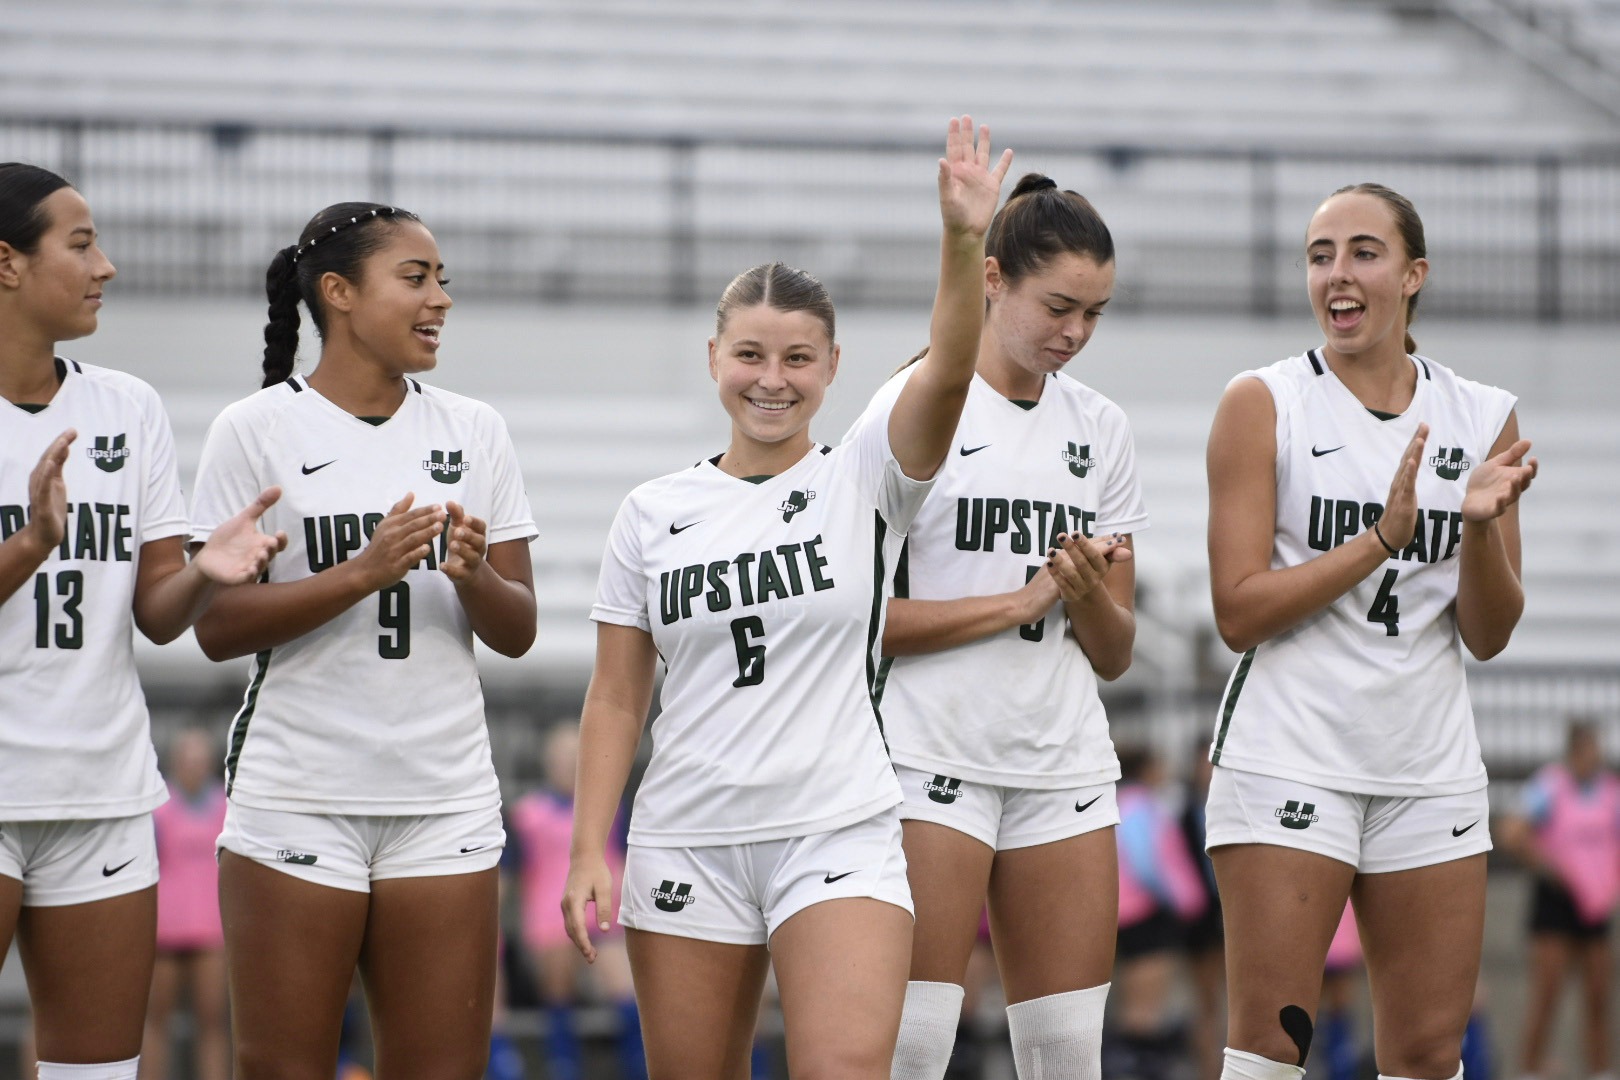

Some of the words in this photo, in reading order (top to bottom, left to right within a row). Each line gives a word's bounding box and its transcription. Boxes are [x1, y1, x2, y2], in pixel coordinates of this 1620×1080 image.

[423, 460, 470, 475] Upstate
[33, 570, 84, 650] 13
[660, 534, 836, 626] UPSTATE
[1367, 569, 1400, 637] 4
[378, 581, 411, 660] 9
[730, 615, 767, 689] 6
[1275, 807, 1320, 823] Upstate
[651, 887, 696, 905] Upstate
